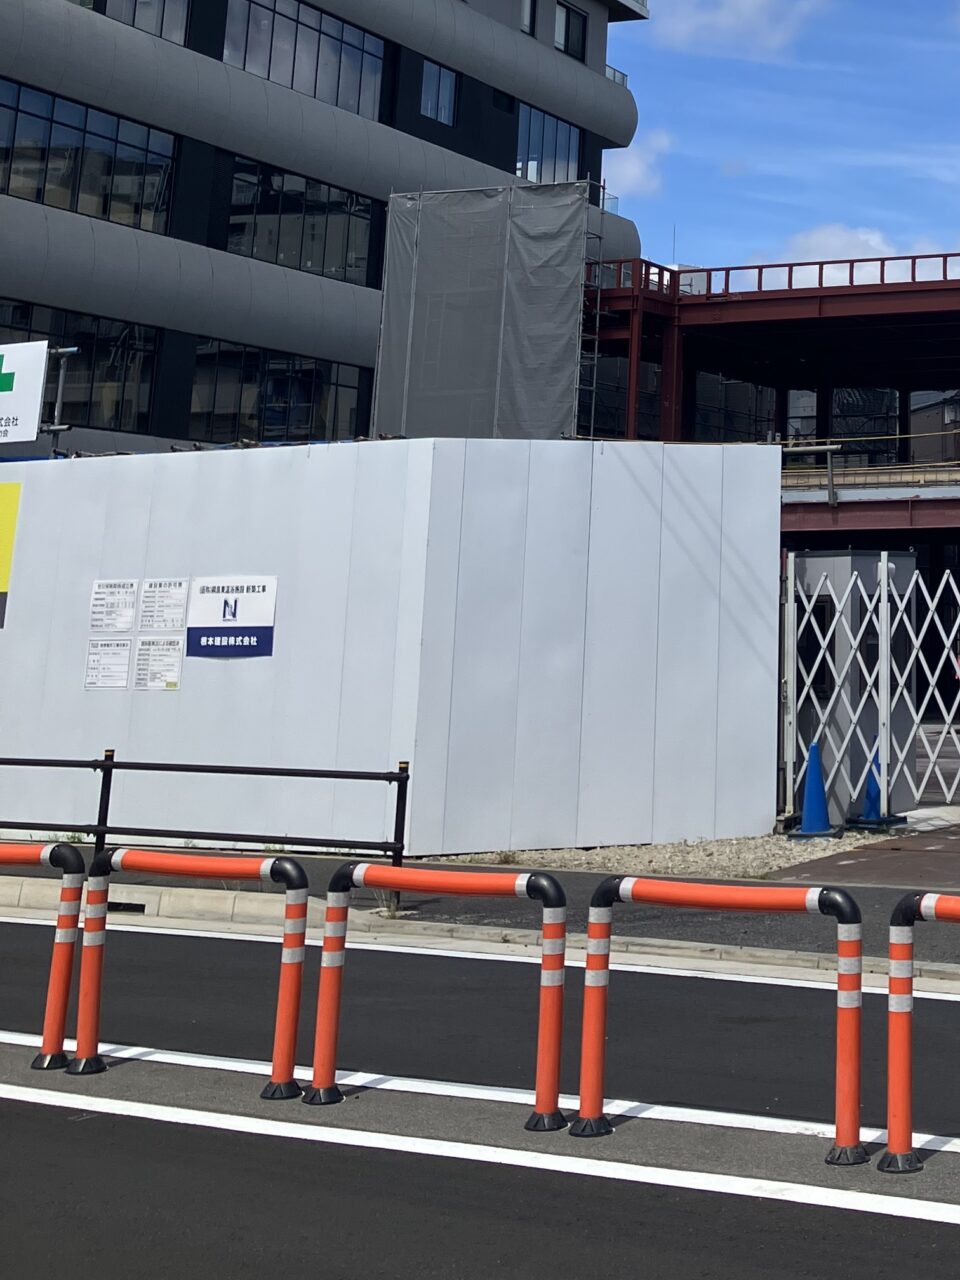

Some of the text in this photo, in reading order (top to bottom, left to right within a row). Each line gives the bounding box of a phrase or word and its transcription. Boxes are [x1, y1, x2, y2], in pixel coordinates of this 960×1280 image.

[200, 636, 257, 646] 根本建設株式会社
